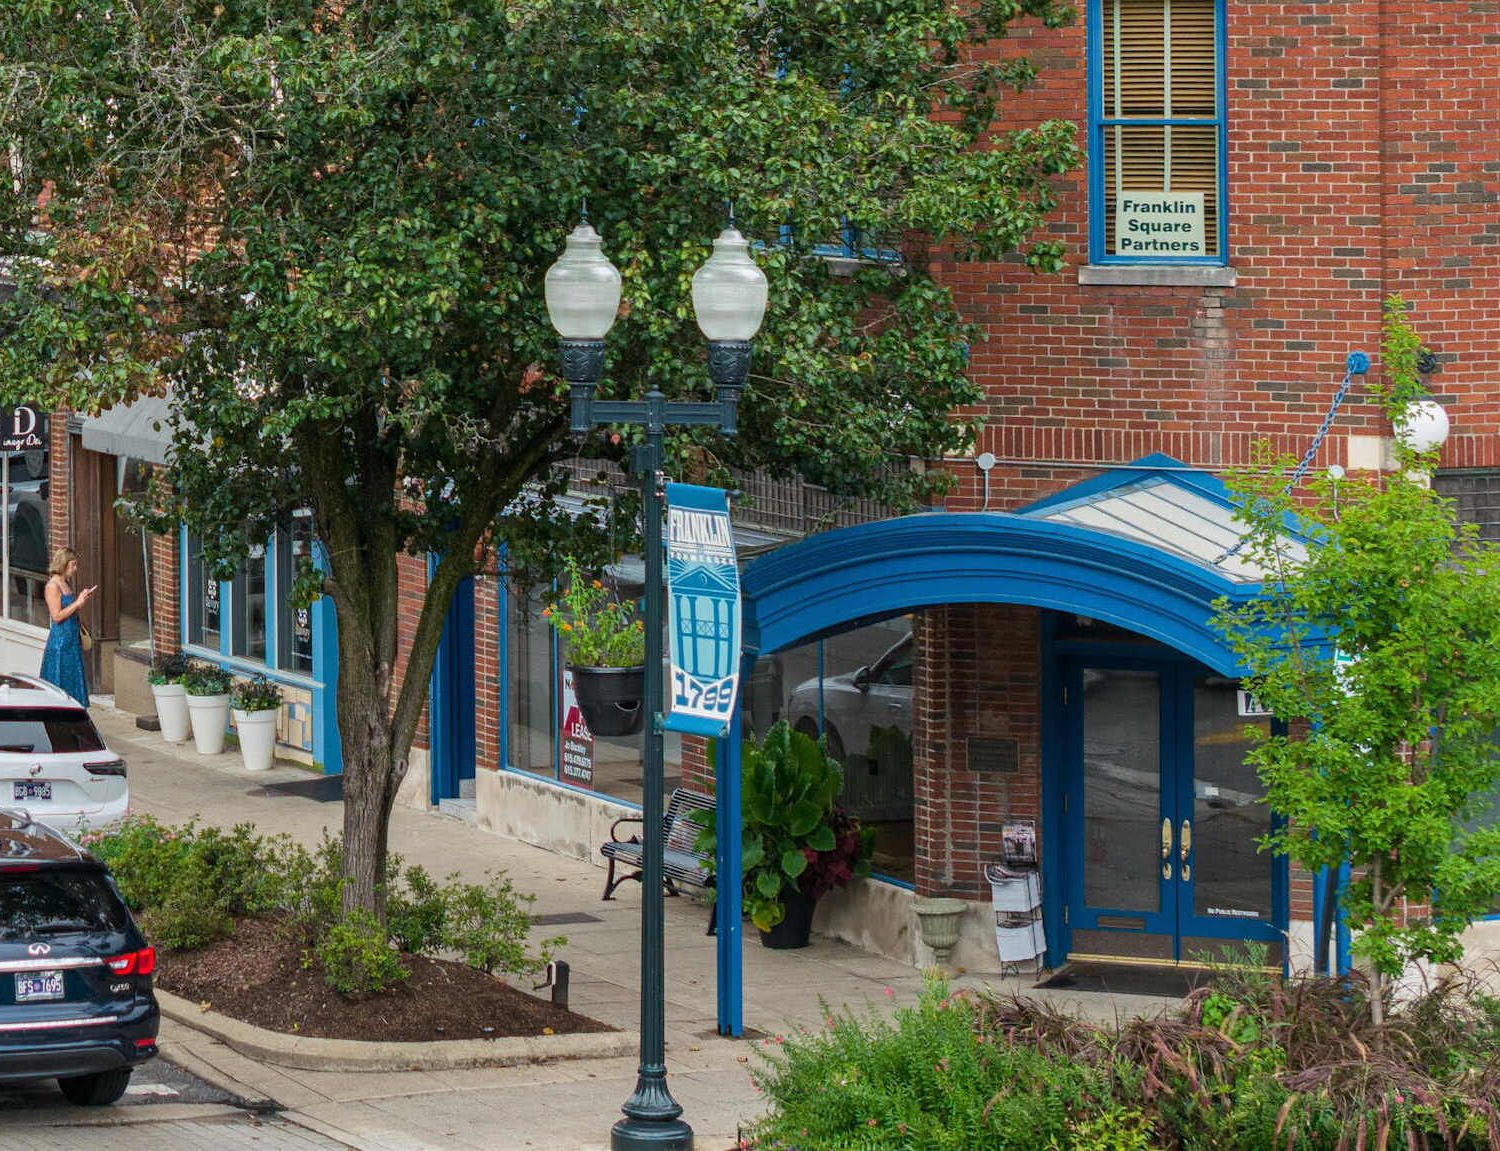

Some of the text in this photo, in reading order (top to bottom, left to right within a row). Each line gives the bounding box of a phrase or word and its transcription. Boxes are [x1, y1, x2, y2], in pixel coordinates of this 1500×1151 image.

[1123, 200, 1196, 213] Franklin
[1128, 219, 1192, 235] Square
[1121, 238, 1200, 251] Partners
[670, 509, 733, 547] FRANKLIN
[675, 672, 734, 713] 1799
[41, 979, 62, 993] 7695
